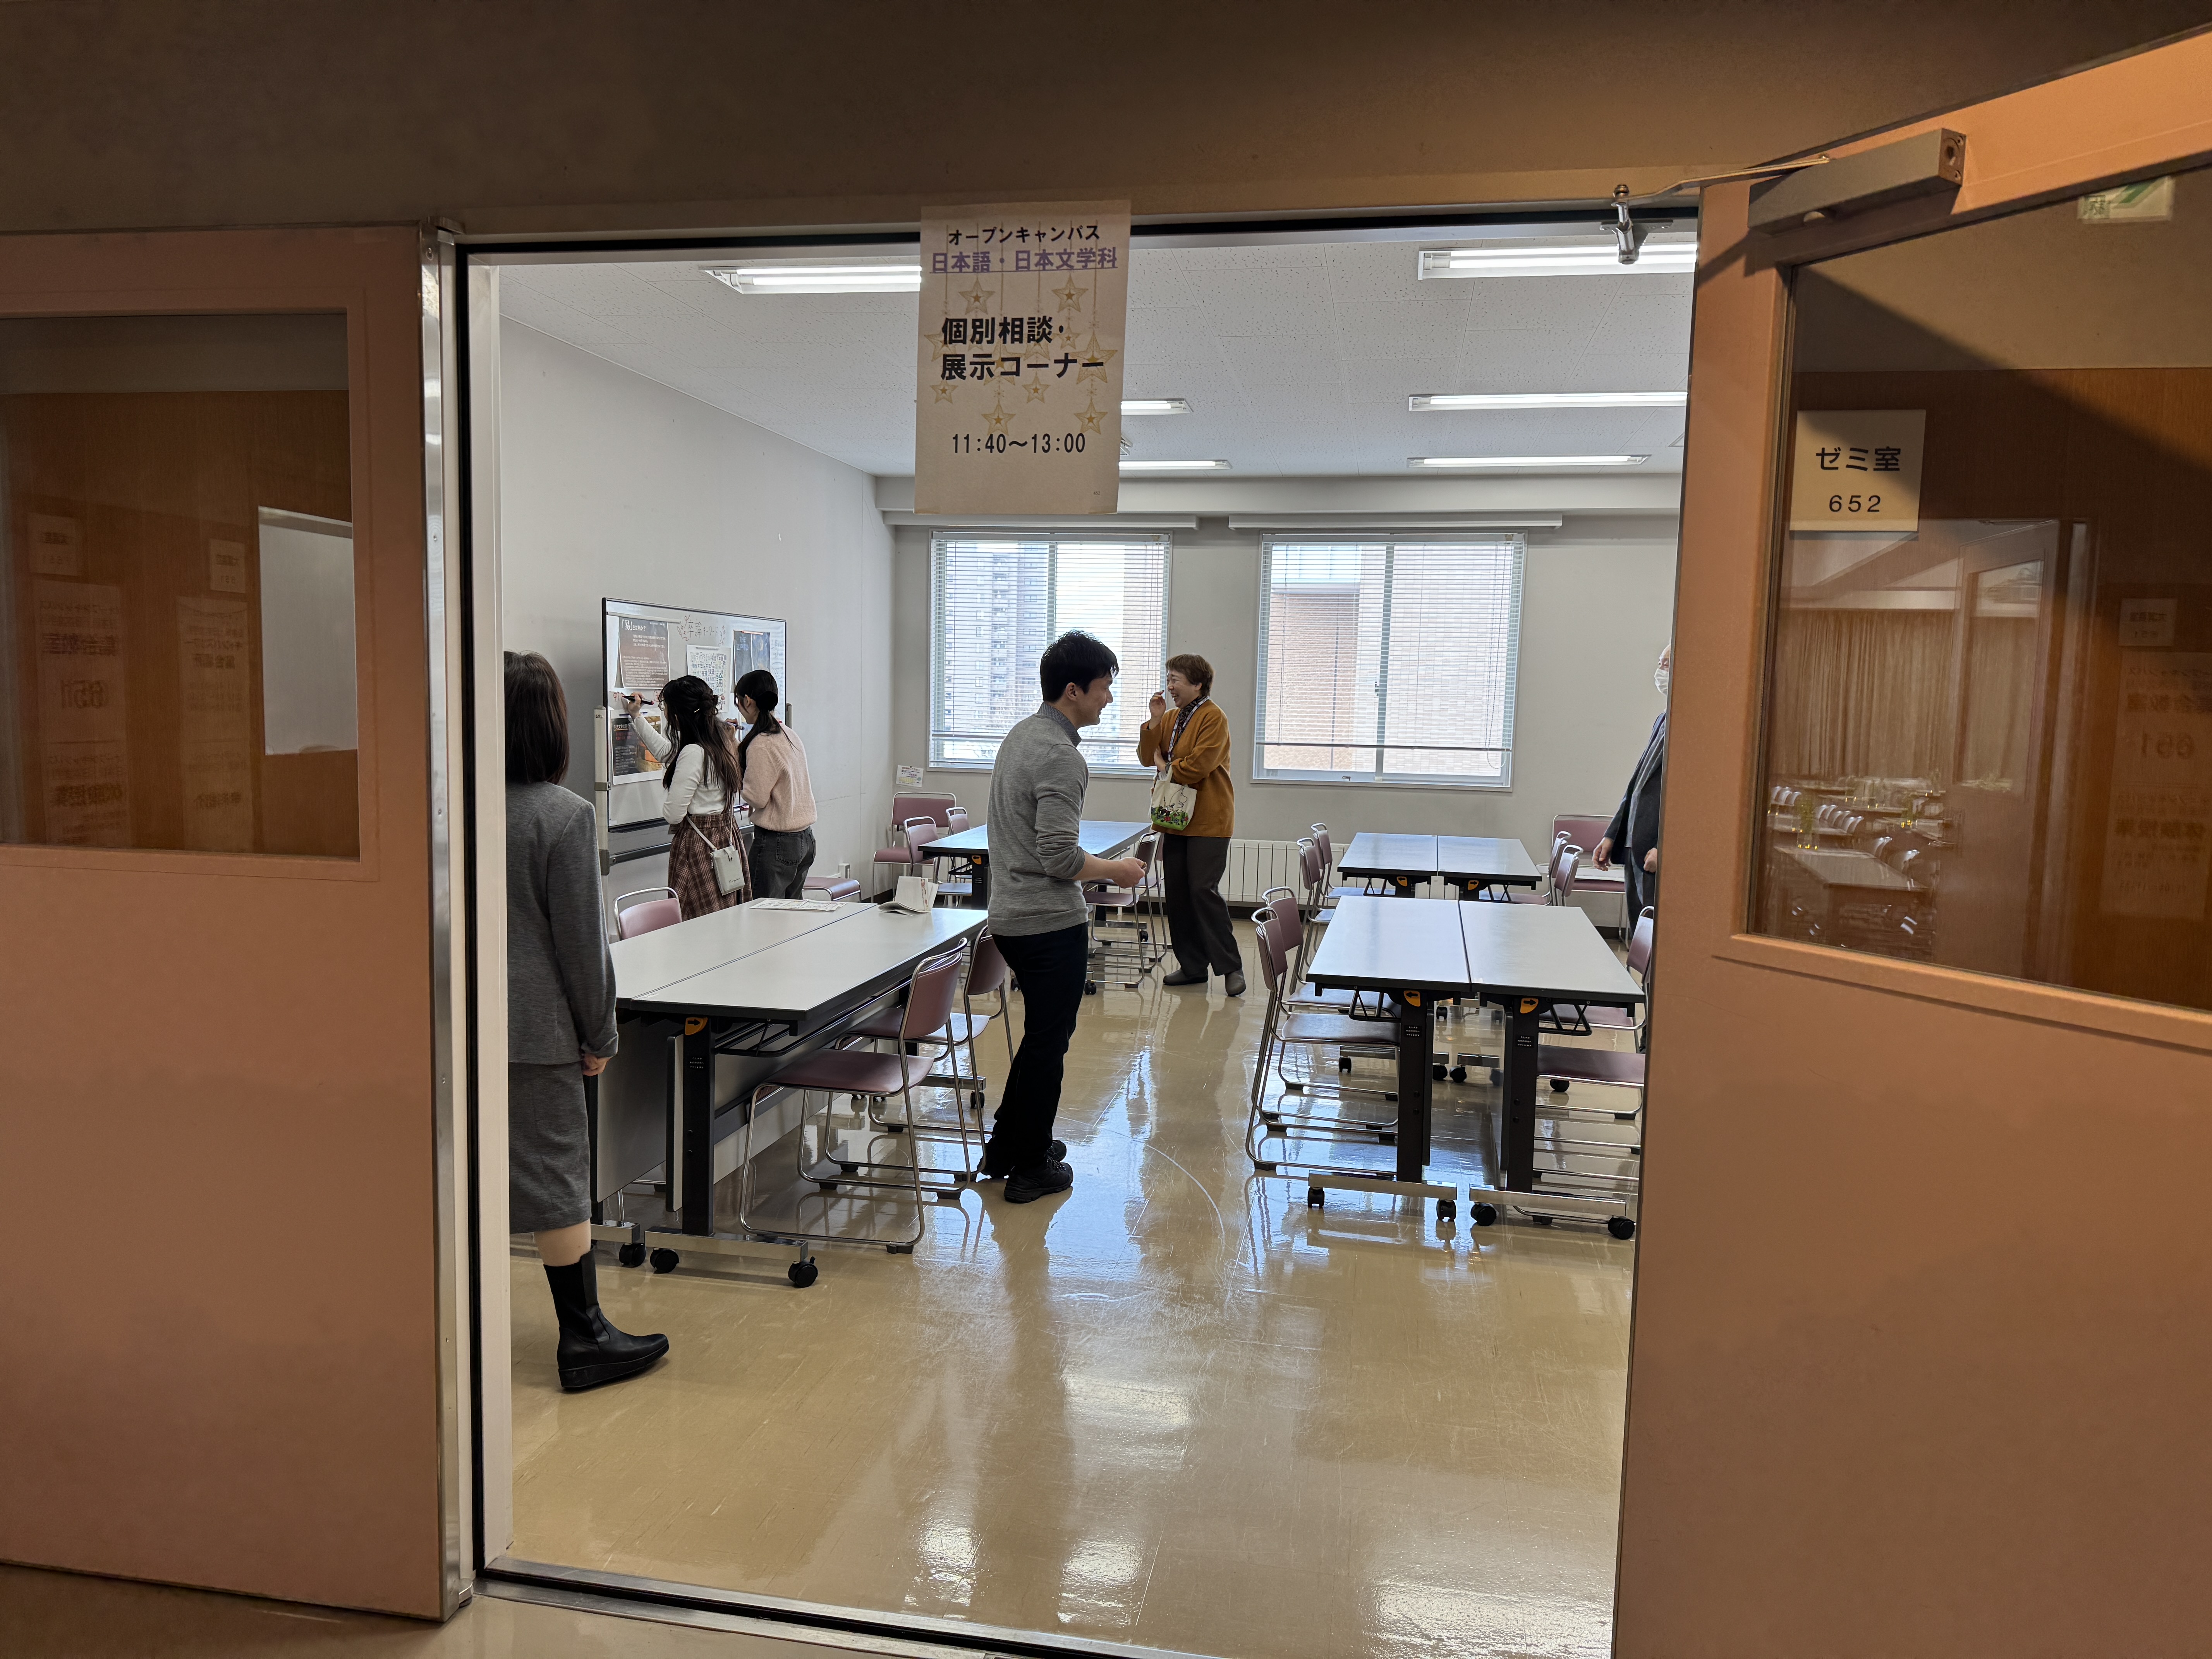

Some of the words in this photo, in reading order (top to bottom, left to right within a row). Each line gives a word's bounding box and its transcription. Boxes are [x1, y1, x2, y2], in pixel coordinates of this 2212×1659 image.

[947, 224, 1100, 246] オープンキャンパス
[932, 246, 1118, 273] 日本語・日本文学科
[941, 316, 1064, 345] 個別相談・
[940, 352, 1104, 381] 展示コーナー
[1815, 446, 1901, 472] ゼミ室
[1829, 495, 1881, 512] 652
